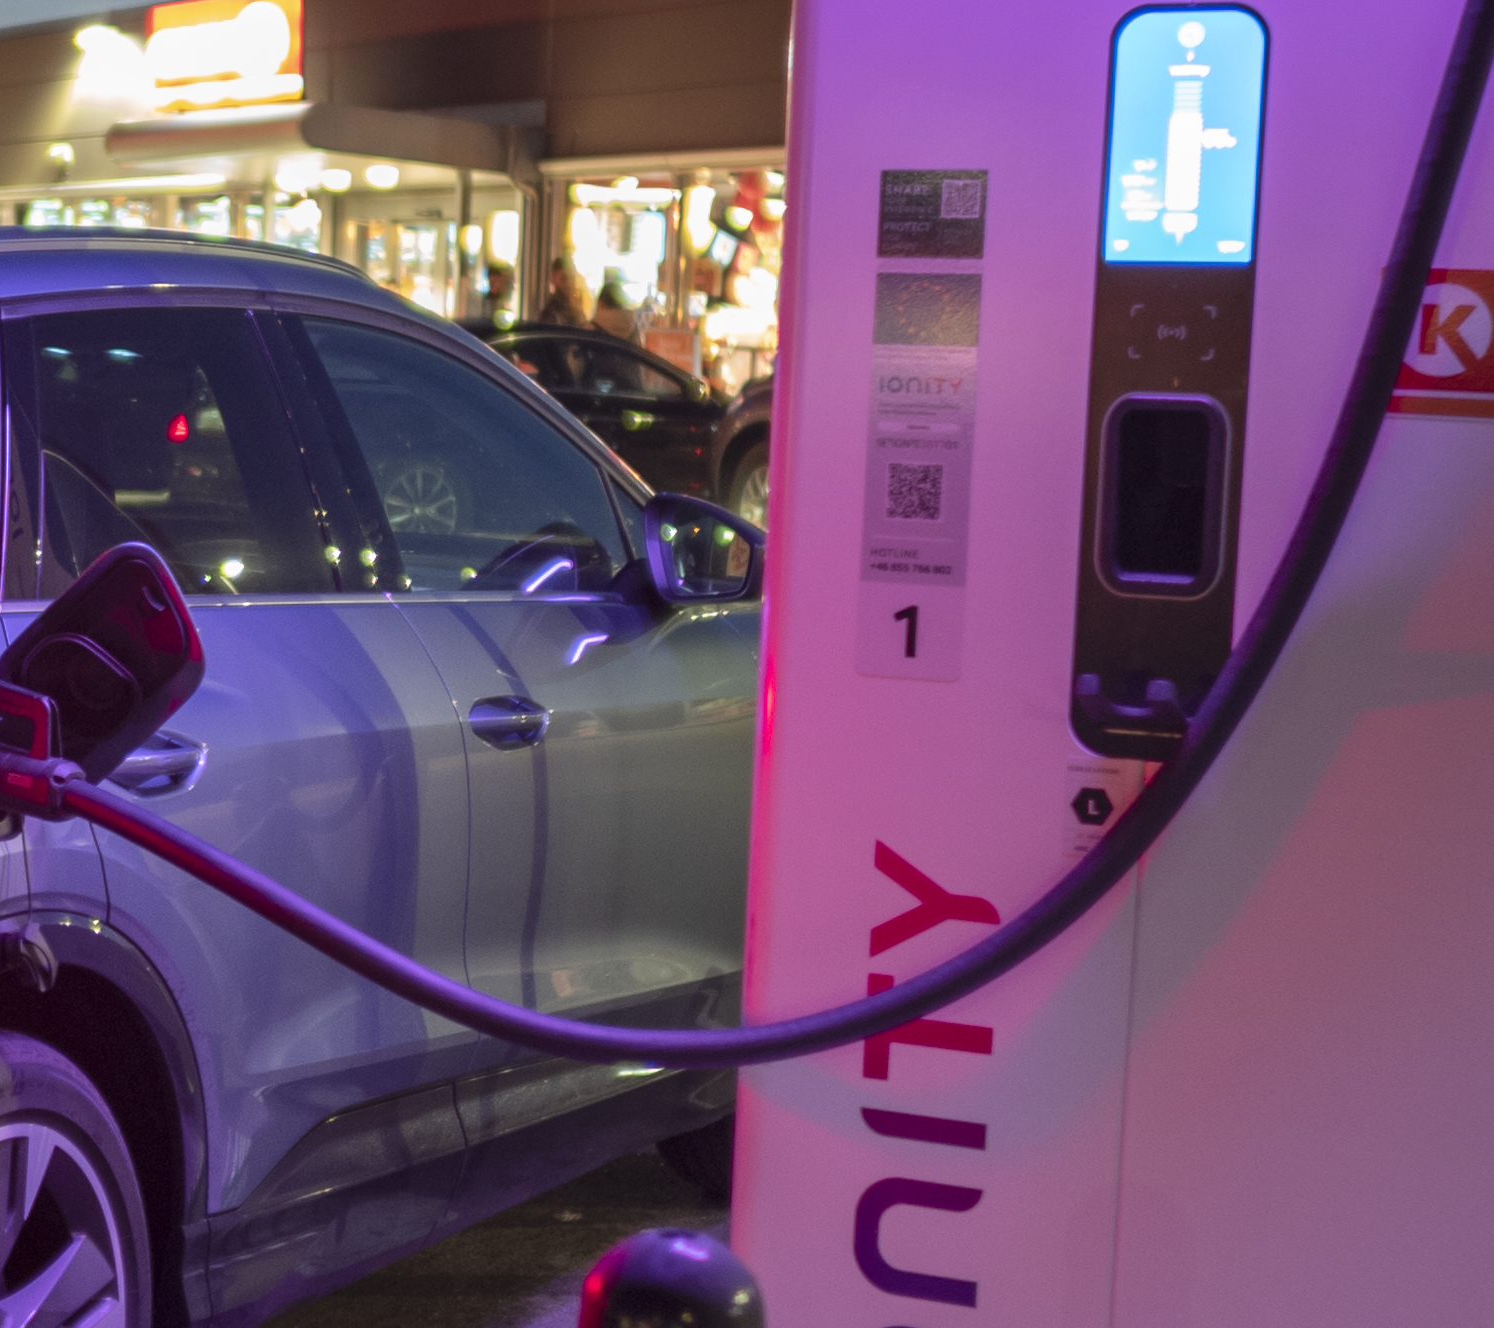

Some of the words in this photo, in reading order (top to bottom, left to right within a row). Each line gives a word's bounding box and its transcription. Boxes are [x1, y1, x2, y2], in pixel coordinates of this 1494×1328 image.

[1418, 302, 1481, 372] K
[878, 375, 964, 394] IONITY
[869, 548, 919, 559] HOTLINE
[893, 604, 919, 658] 1
[1087, 798, 1100, 815] L
